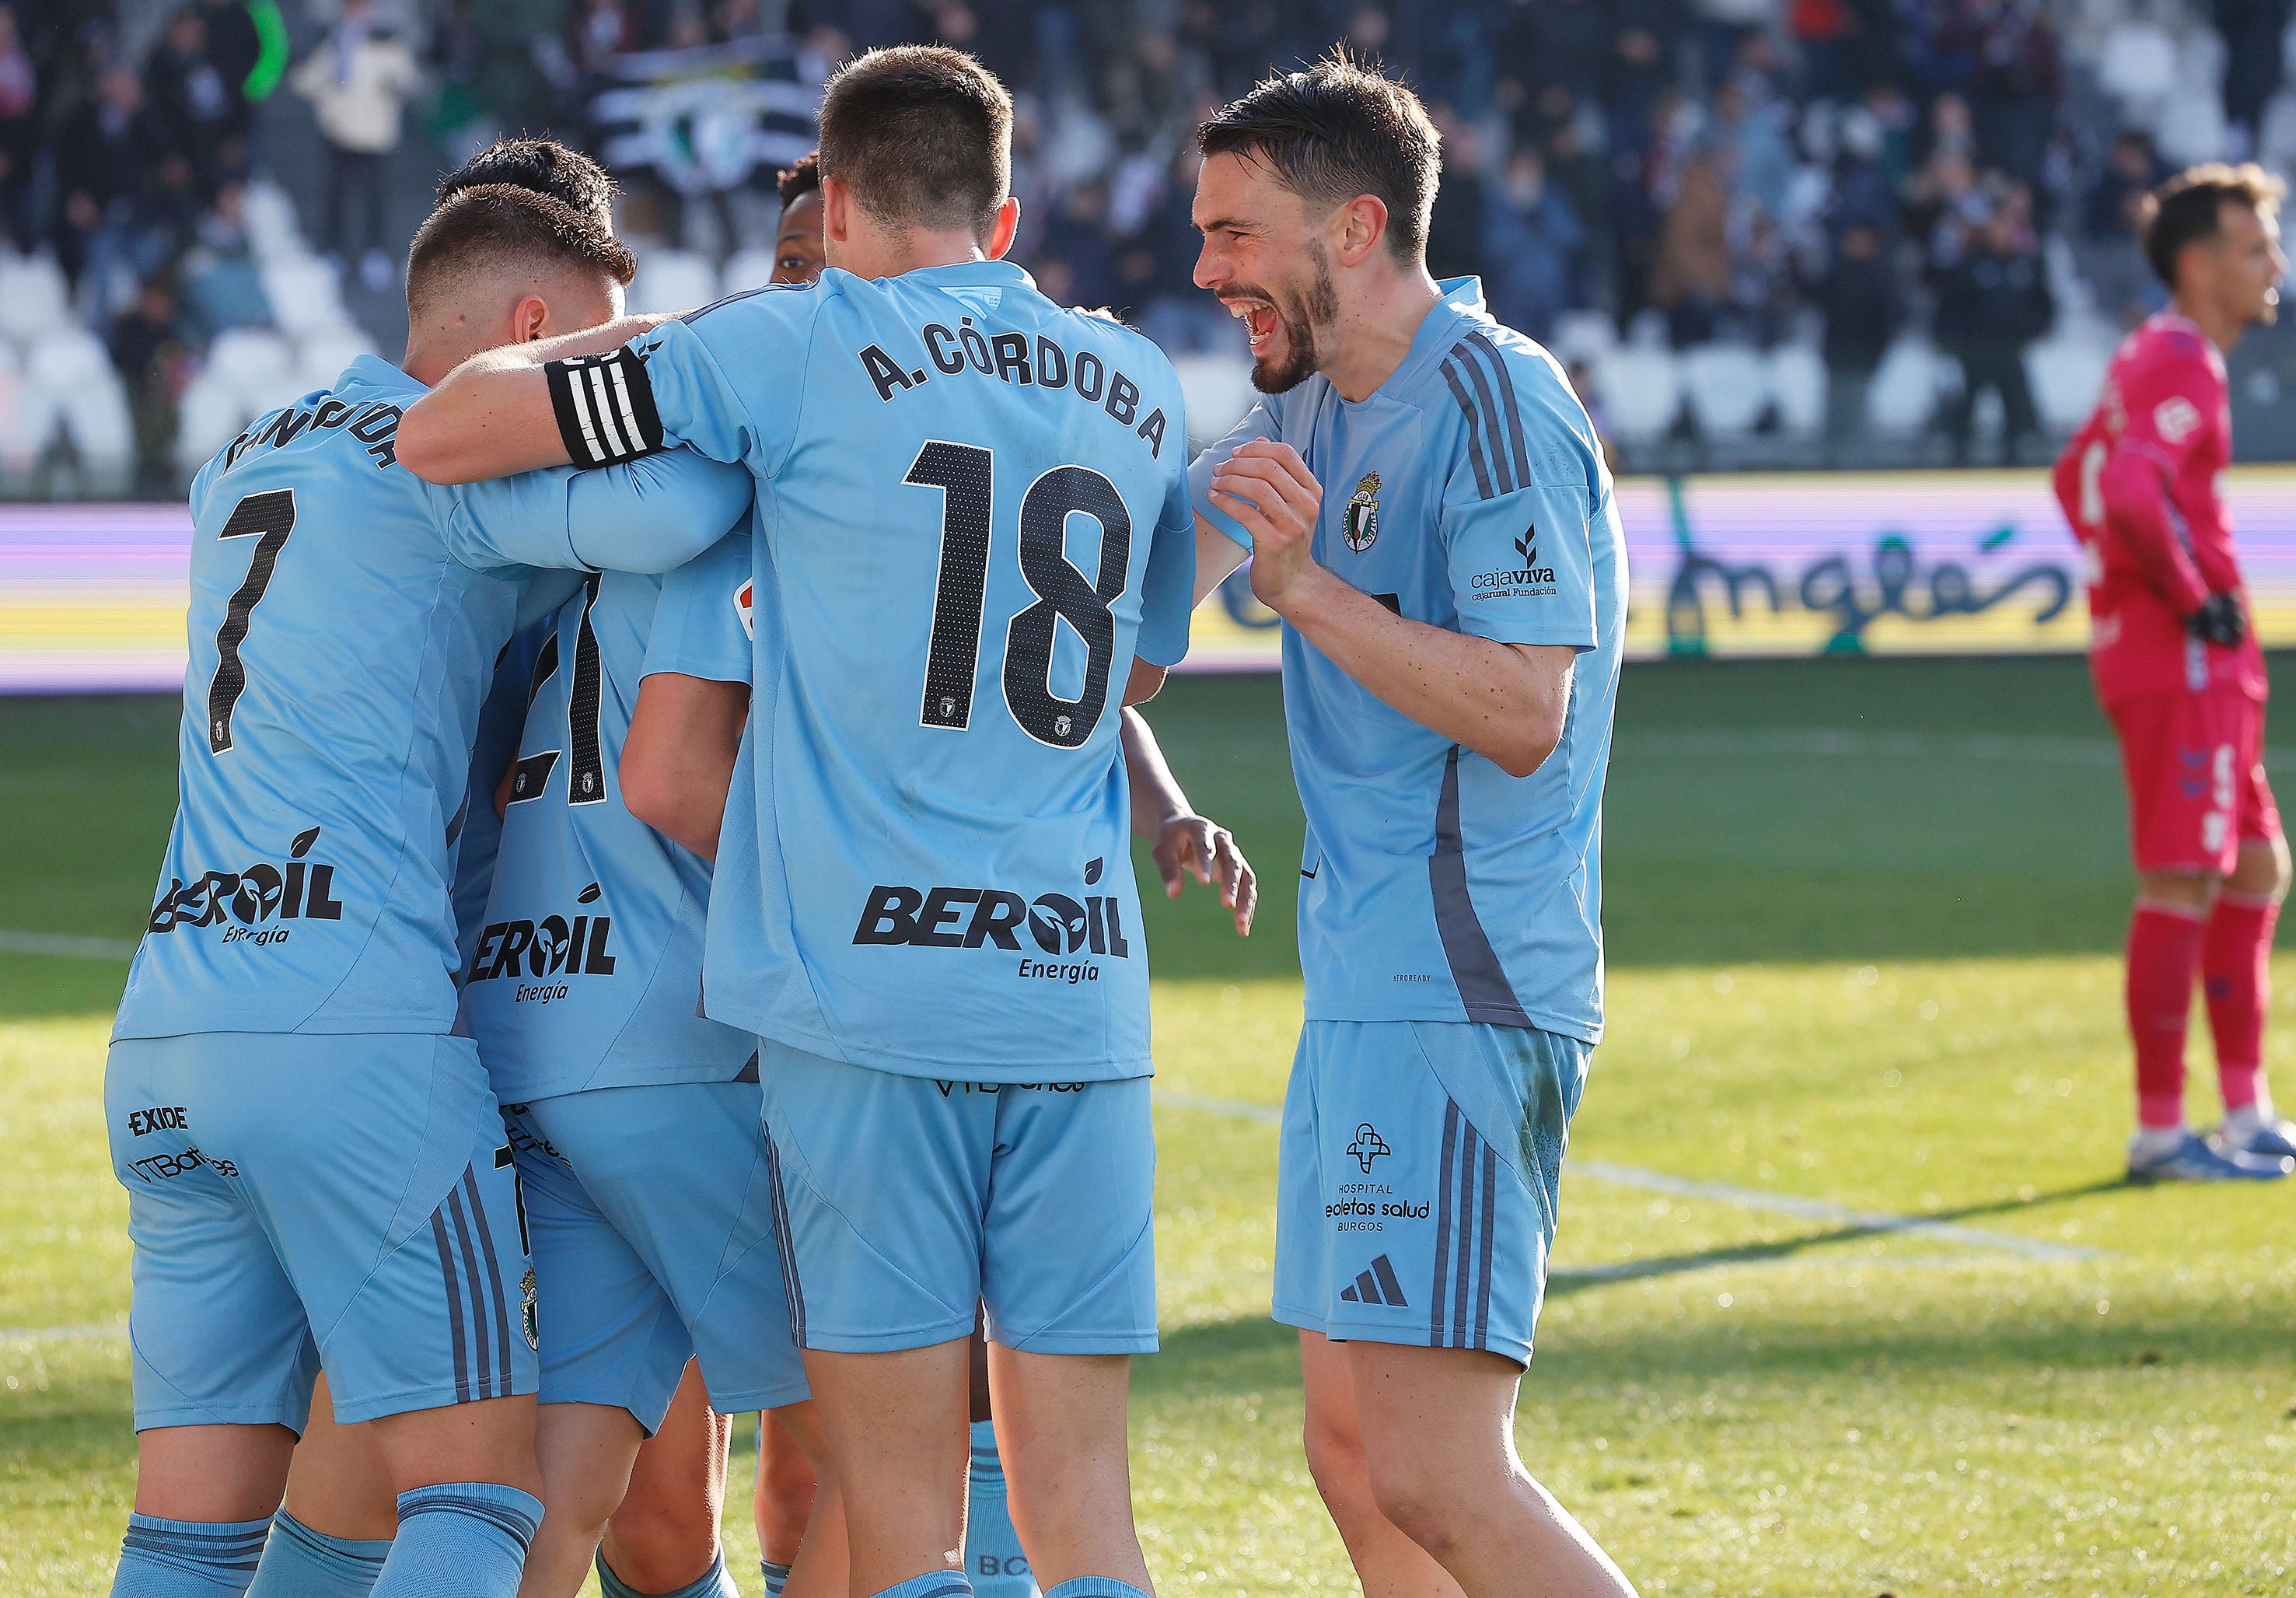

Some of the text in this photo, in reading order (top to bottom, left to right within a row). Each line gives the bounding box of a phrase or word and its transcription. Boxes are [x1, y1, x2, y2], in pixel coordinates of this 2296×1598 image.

[858, 316, 1168, 463] A. CÓRDOBA
[1471, 568, 1556, 590] cajaviva
[900, 439, 1134, 750] 18
[1472, 586, 1557, 602] cajarural Fundación
[208, 488, 296, 757] 7
[465, 882, 617, 984] EROIL
[1019, 959, 1099, 984] Energía
[1393, 974, 1431, 983] AEROREADY
[515, 980, 569, 1005] Energía
[128, 1107, 189, 1137] EXIDE
[1338, 1184, 1393, 1194] HOSPITAL
[1381, 1200, 1430, 1219] salud
[1337, 1222, 1383, 1232] BURGOS
[980, 1555, 1033, 1576] BC
